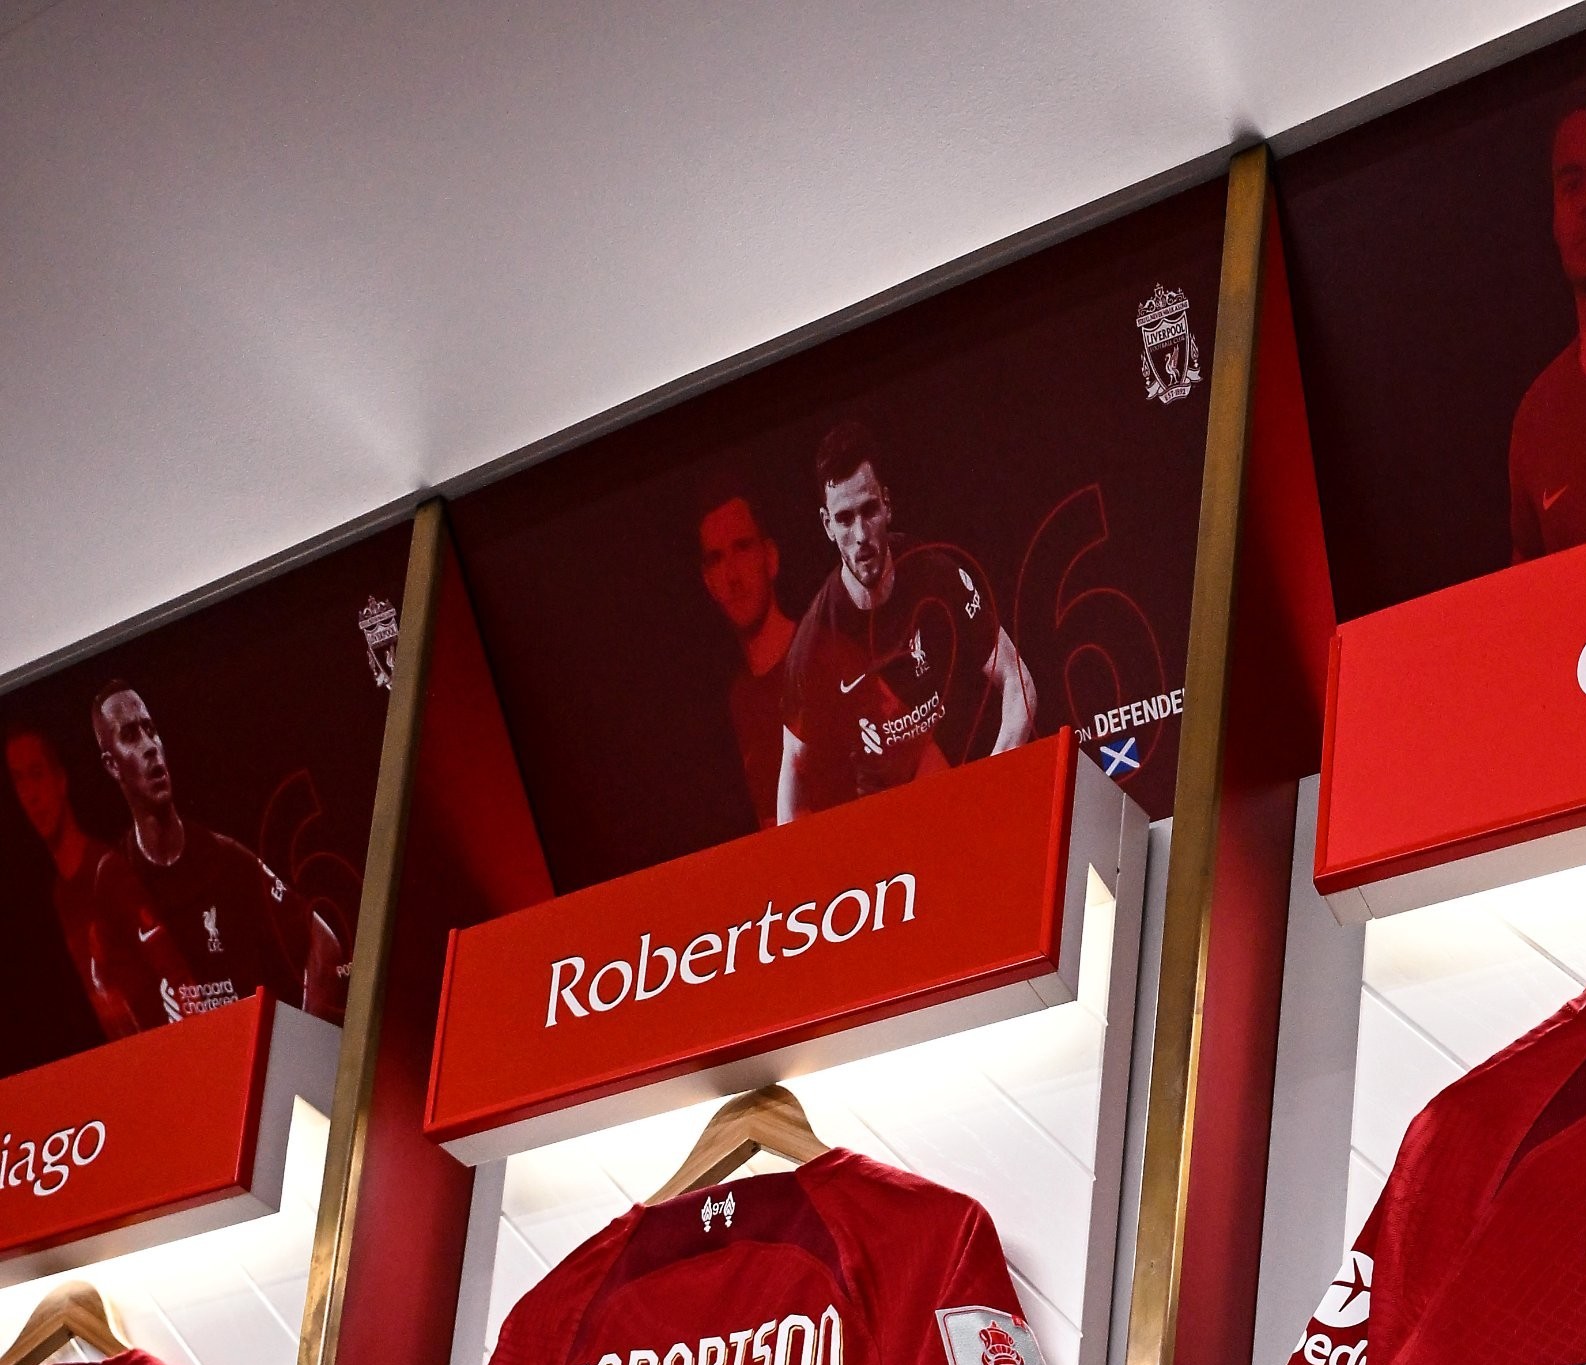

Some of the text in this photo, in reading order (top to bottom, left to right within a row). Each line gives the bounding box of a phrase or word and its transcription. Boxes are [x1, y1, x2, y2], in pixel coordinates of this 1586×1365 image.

[1146, 323, 1186, 345] LIVERPOOL
[882, 690, 941, 735] standard
[1094, 687, 1185, 738] DEFENDE
[544, 873, 916, 1028] Robertson
[712, 1201, 726, 1216] 97
